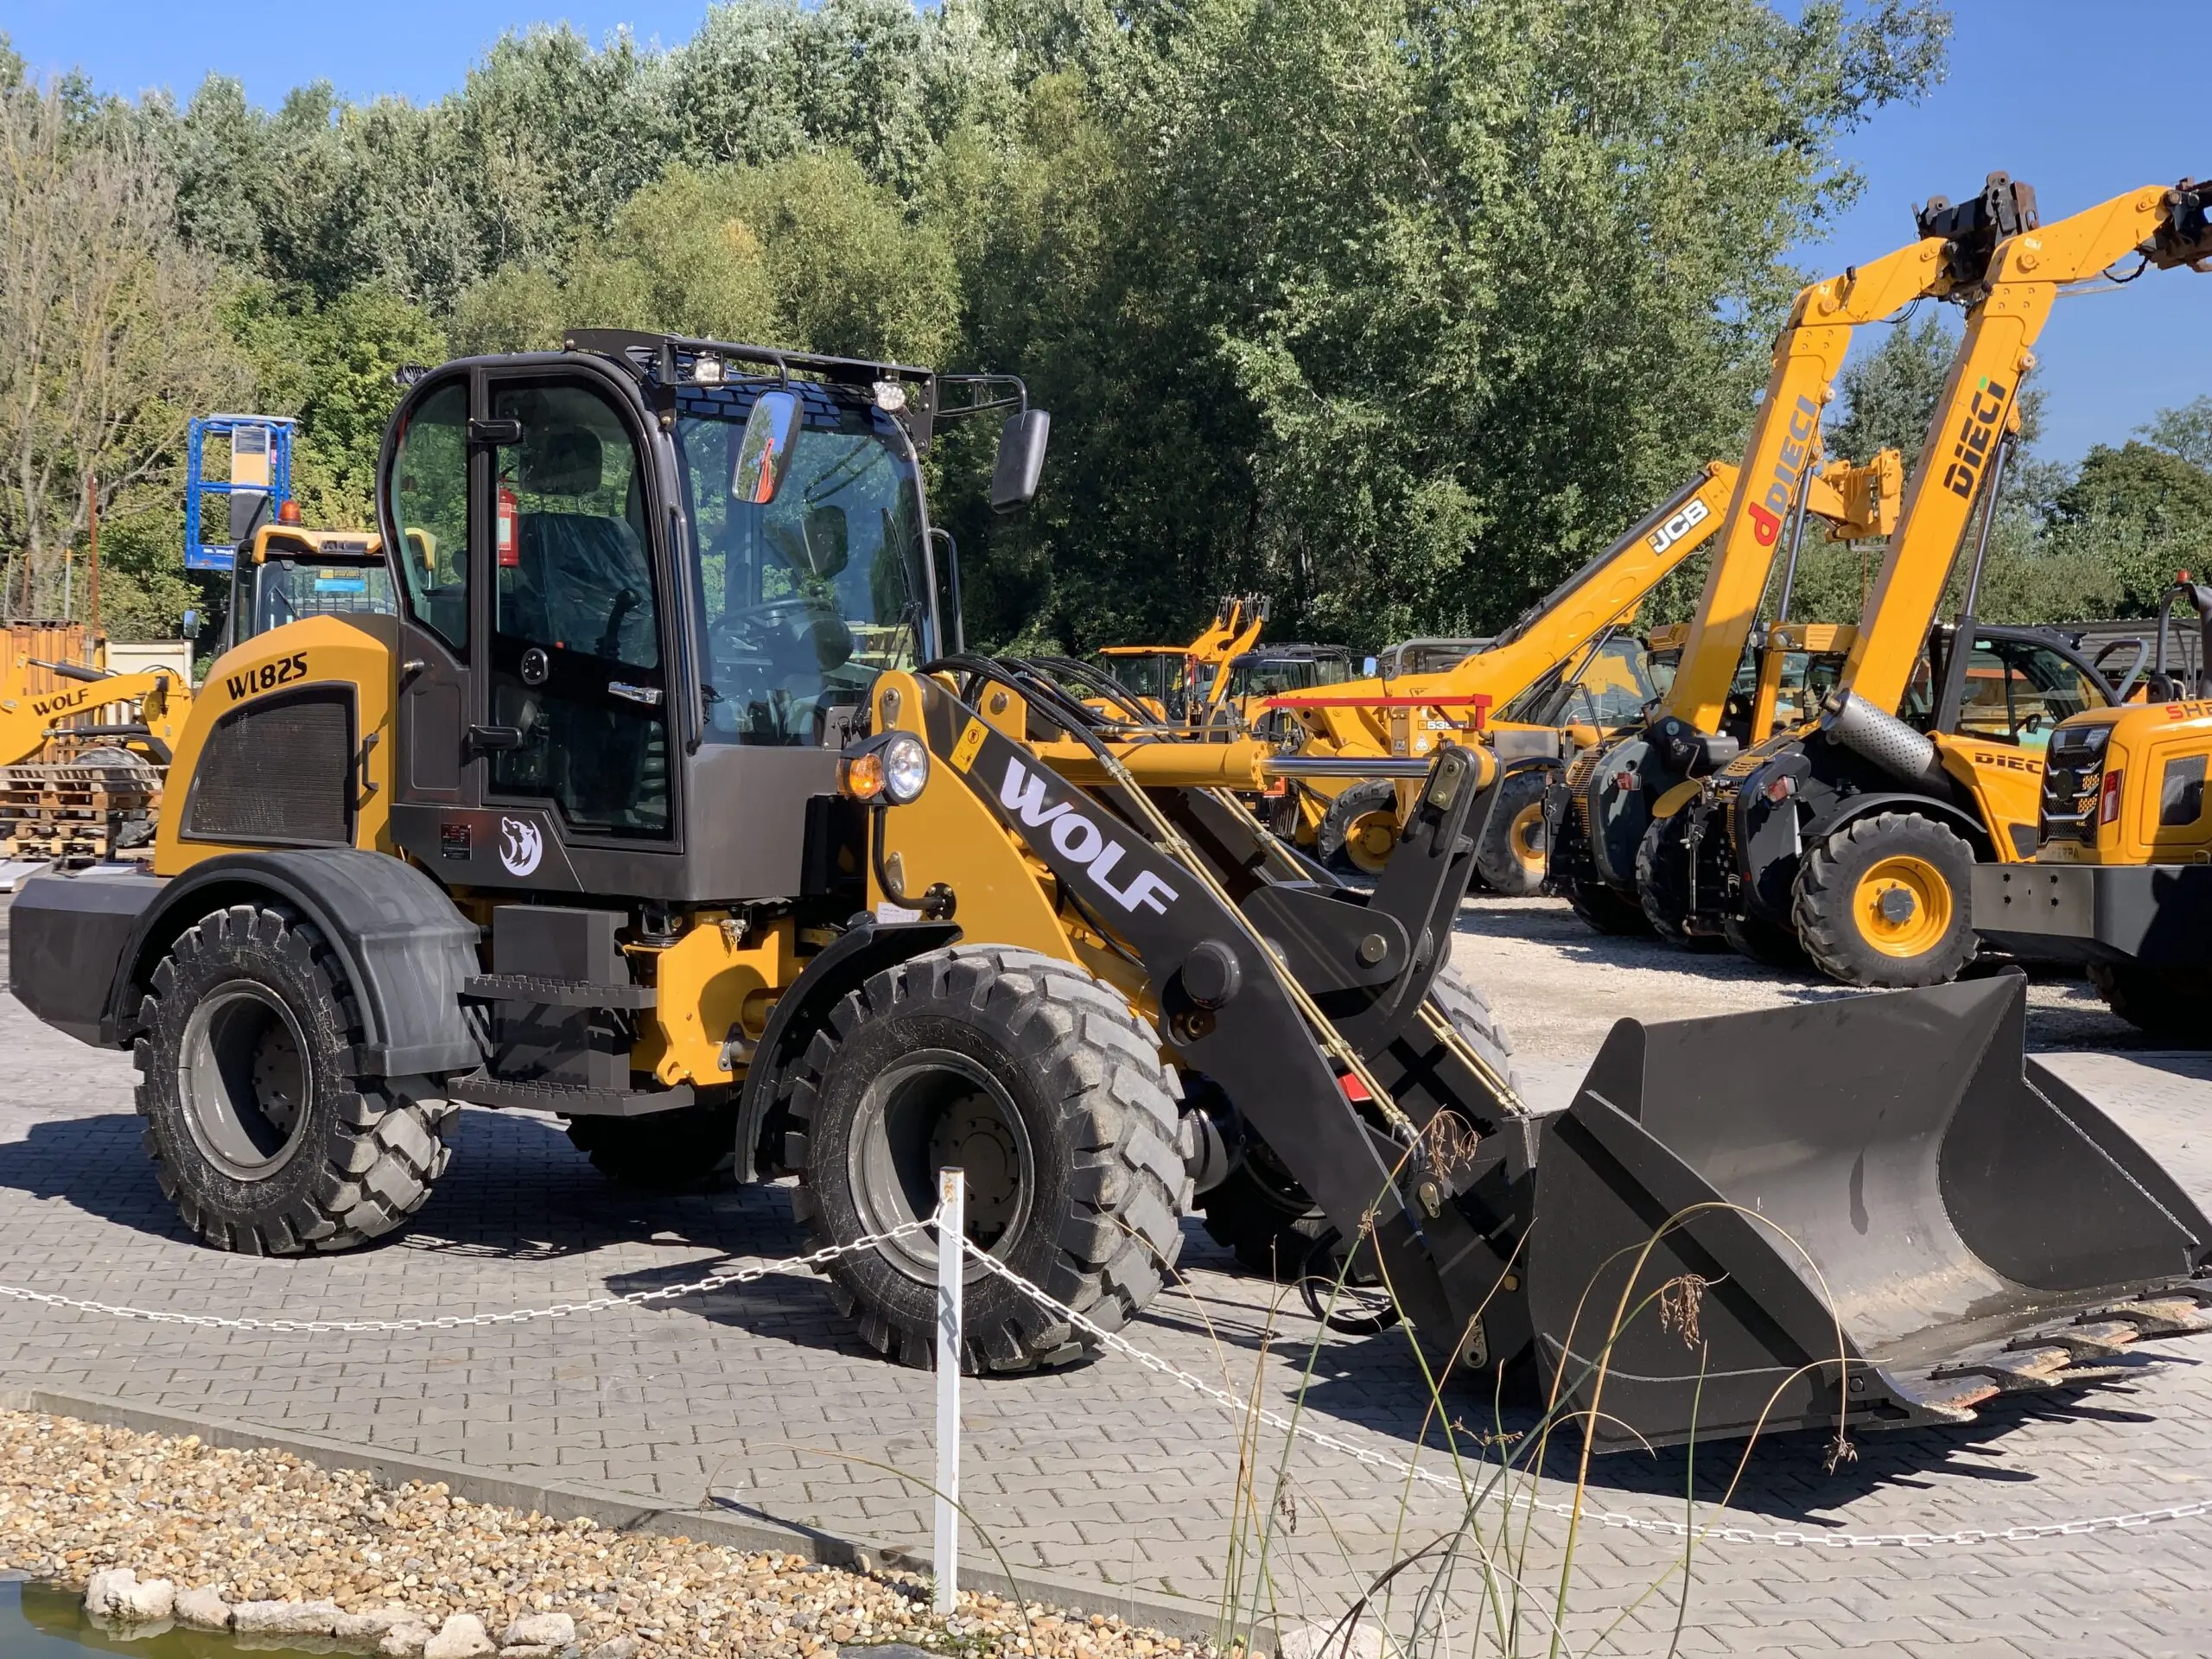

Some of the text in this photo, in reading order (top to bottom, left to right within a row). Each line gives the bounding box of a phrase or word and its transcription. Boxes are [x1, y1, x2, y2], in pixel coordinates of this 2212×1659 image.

[1943, 376, 2006, 499] DIECI
[1653, 499, 1708, 553] JCB
[32, 688, 89, 716] WOLF
[226, 652, 308, 701] WL825
[1000, 756, 1179, 915] WOLF
